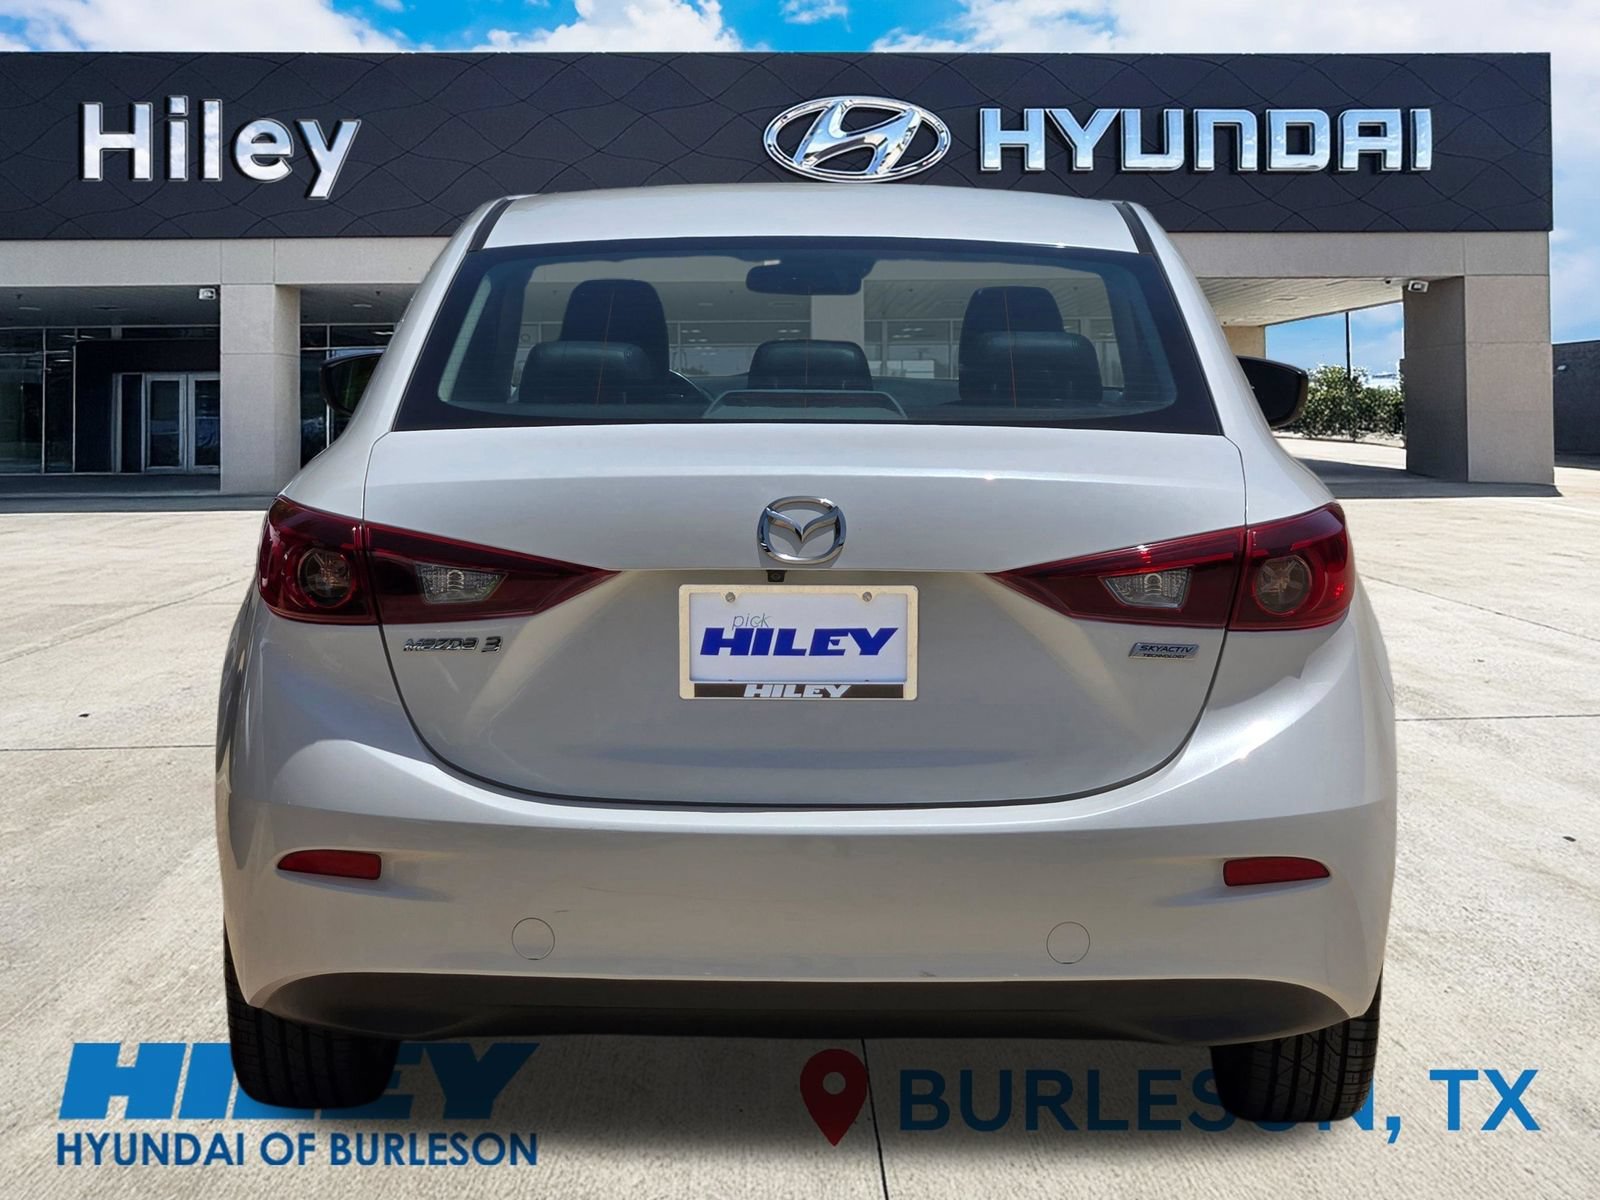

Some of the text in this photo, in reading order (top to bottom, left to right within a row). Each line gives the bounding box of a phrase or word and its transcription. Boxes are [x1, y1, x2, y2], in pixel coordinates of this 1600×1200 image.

[79, 95, 361, 200] Hiley
[979, 107, 1431, 172] HYUNDAI
[731, 612, 772, 631] pick
[481, 636, 503, 652] 3
[700, 627, 899, 656] HILEY
[1139, 644, 1195, 653] SKYACTIV
[743, 684, 852, 698] HILEY
